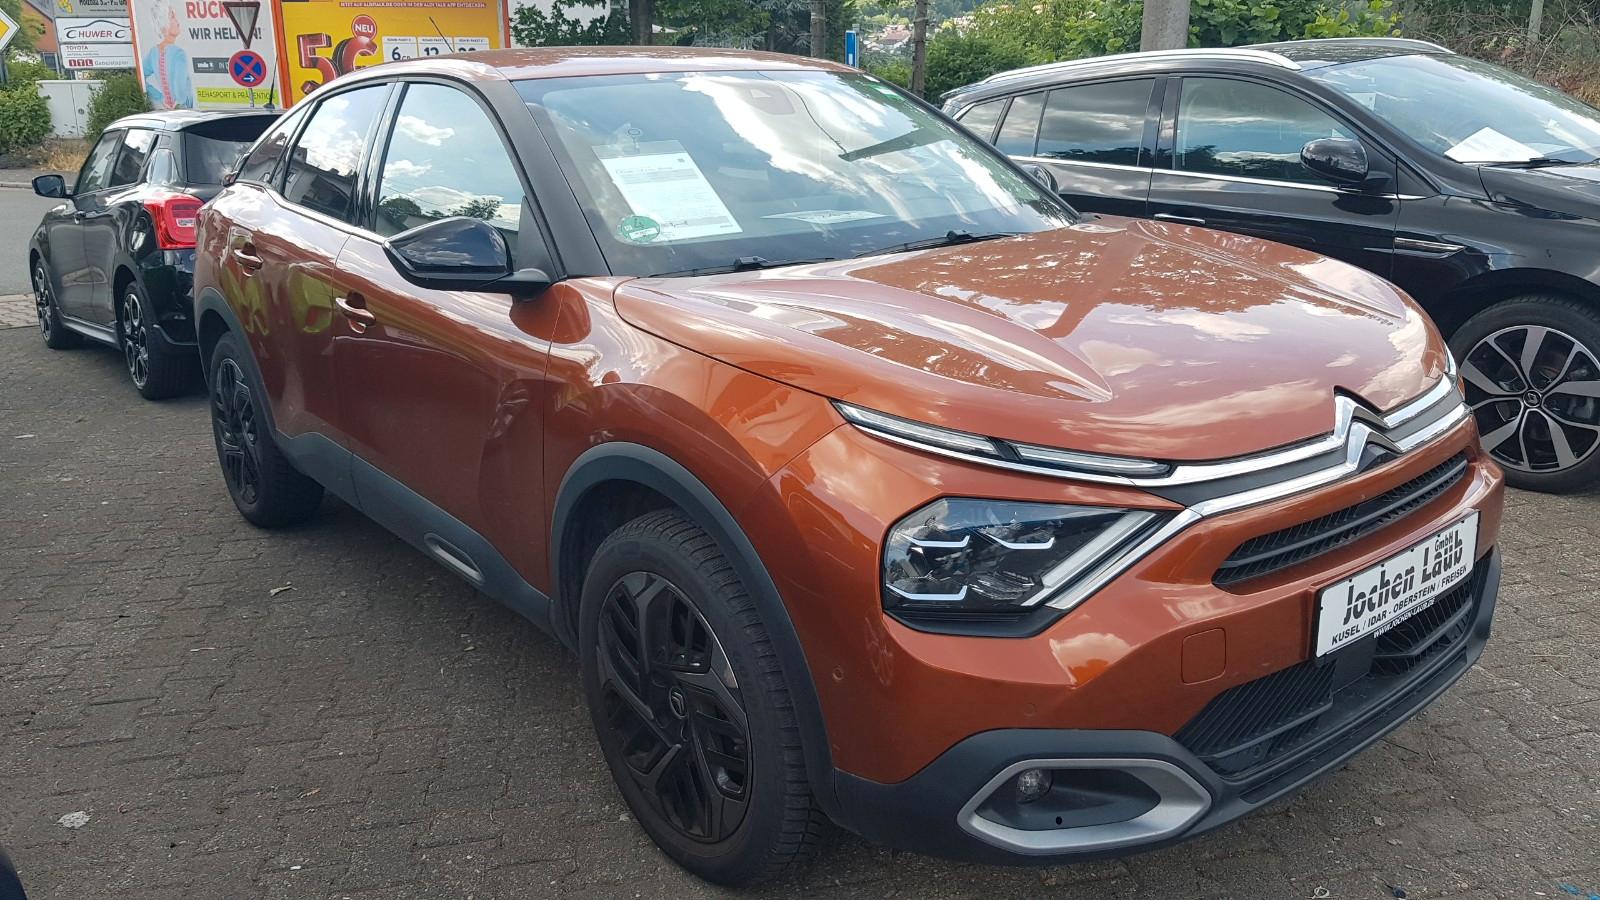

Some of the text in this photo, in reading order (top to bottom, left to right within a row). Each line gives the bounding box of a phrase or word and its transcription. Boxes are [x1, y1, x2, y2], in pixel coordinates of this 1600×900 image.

[188, 27, 212, 40] WIR
[355, 24, 374, 33] NEU
[391, 46, 401, 61] 6
[1434, 531, 1454, 552] GmbH
[1343, 529, 1463, 626] Jochen Laub
[1332, 621, 1361, 646] KUSEL
[1367, 610, 1387, 628] IDAR
[1393, 582, 1436, 614] OBERSTEIN
[1441, 565, 1468, 589] FREISEN
